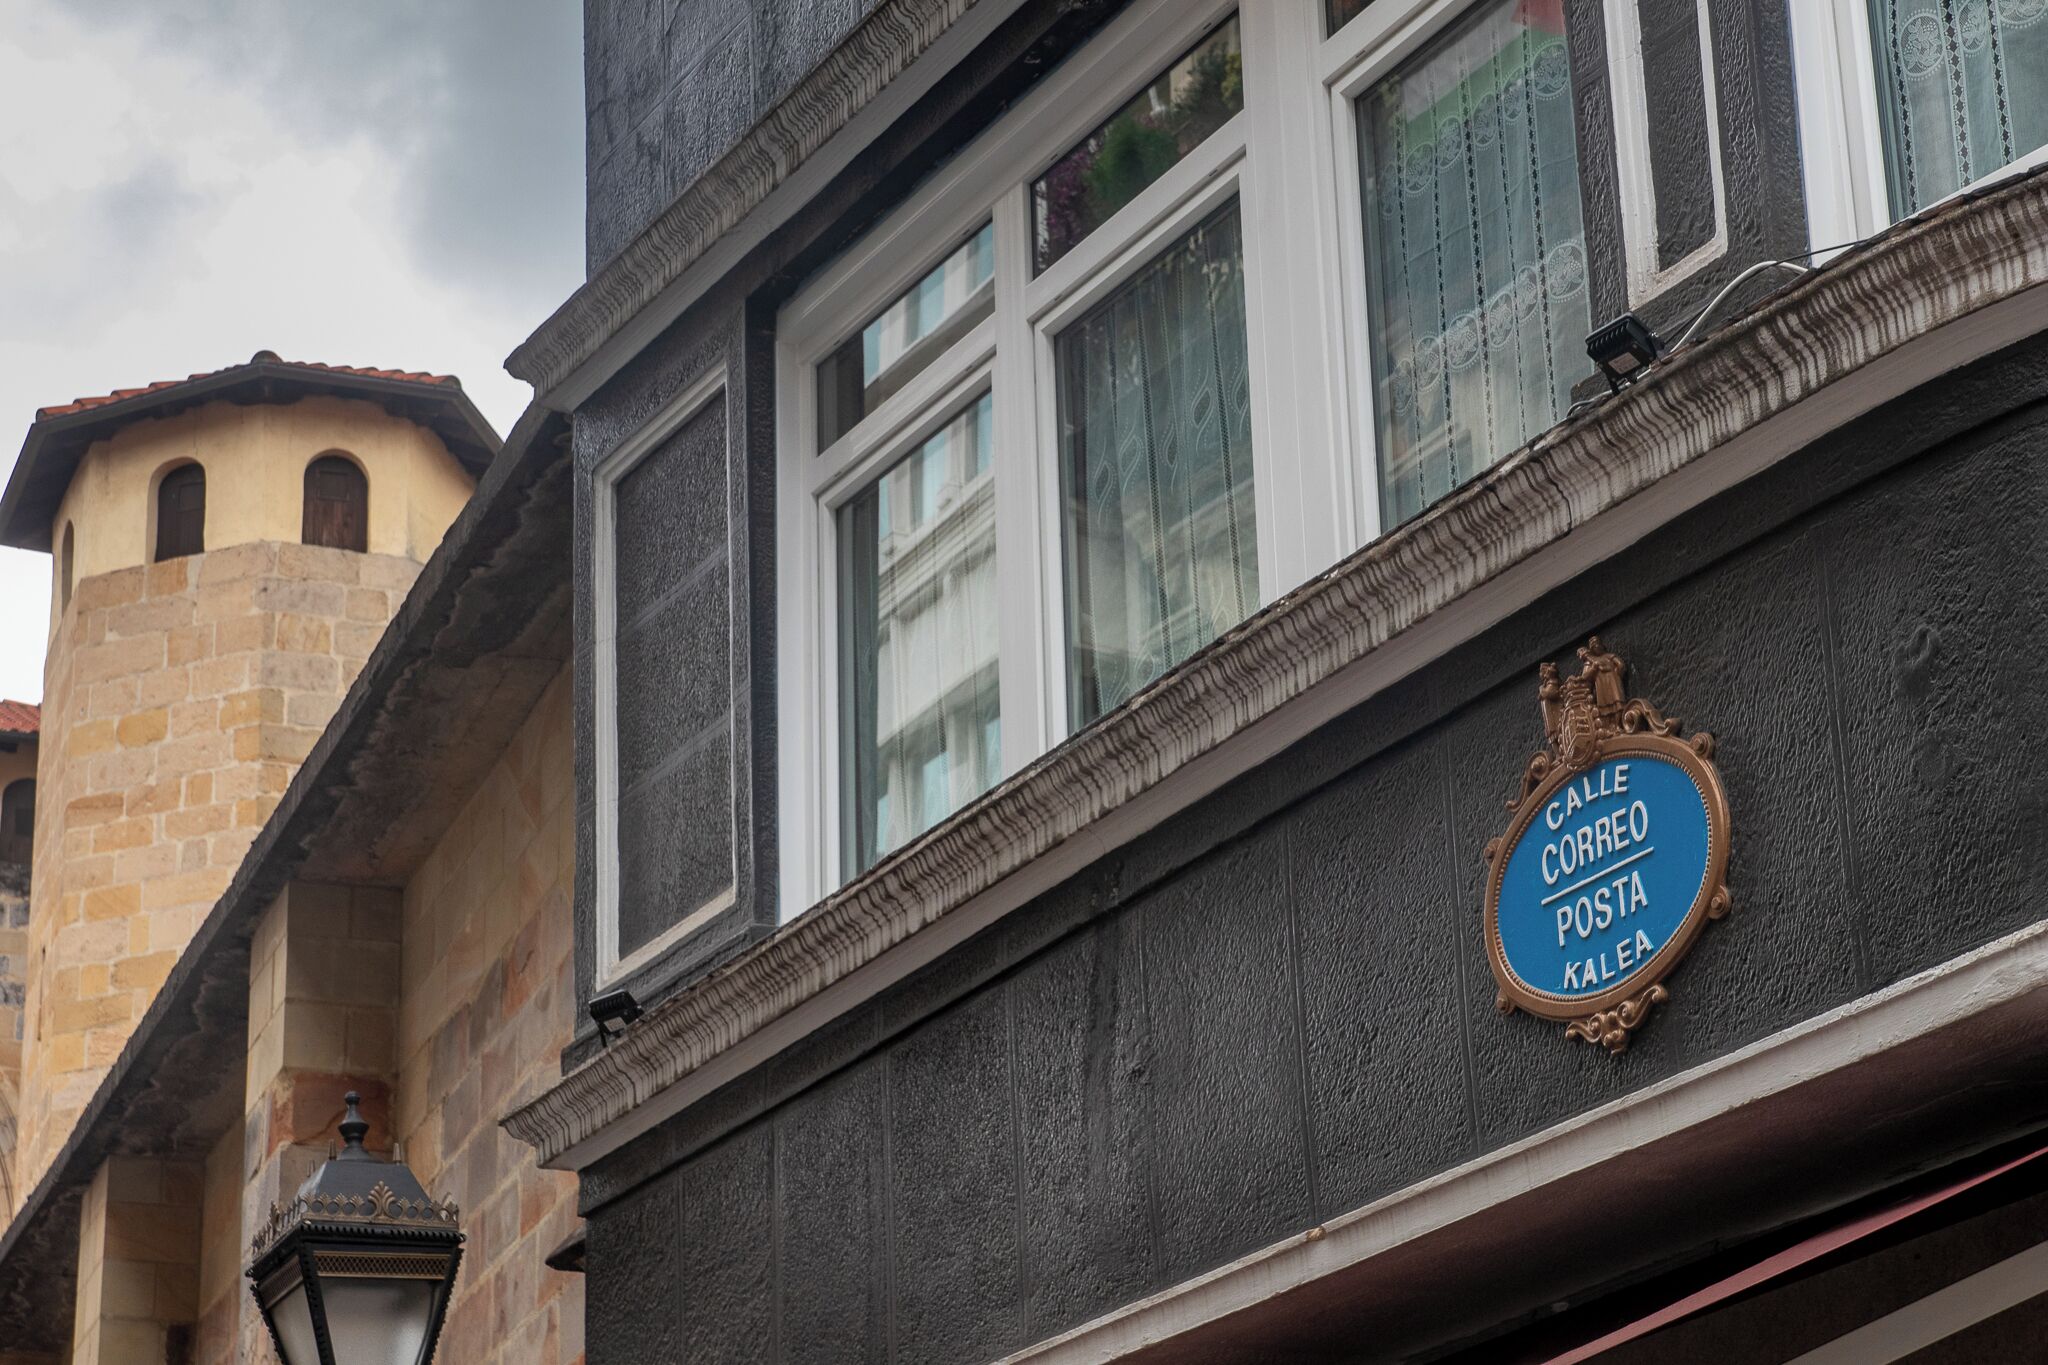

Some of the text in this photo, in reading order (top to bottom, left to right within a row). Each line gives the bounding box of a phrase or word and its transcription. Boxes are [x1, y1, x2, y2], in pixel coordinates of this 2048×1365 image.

[1546, 764, 1629, 831] CALLE
[1541, 800, 1649, 885] CORREO
[1556, 870, 1648, 947] POSTA
[1563, 929, 1654, 990] KALEA
